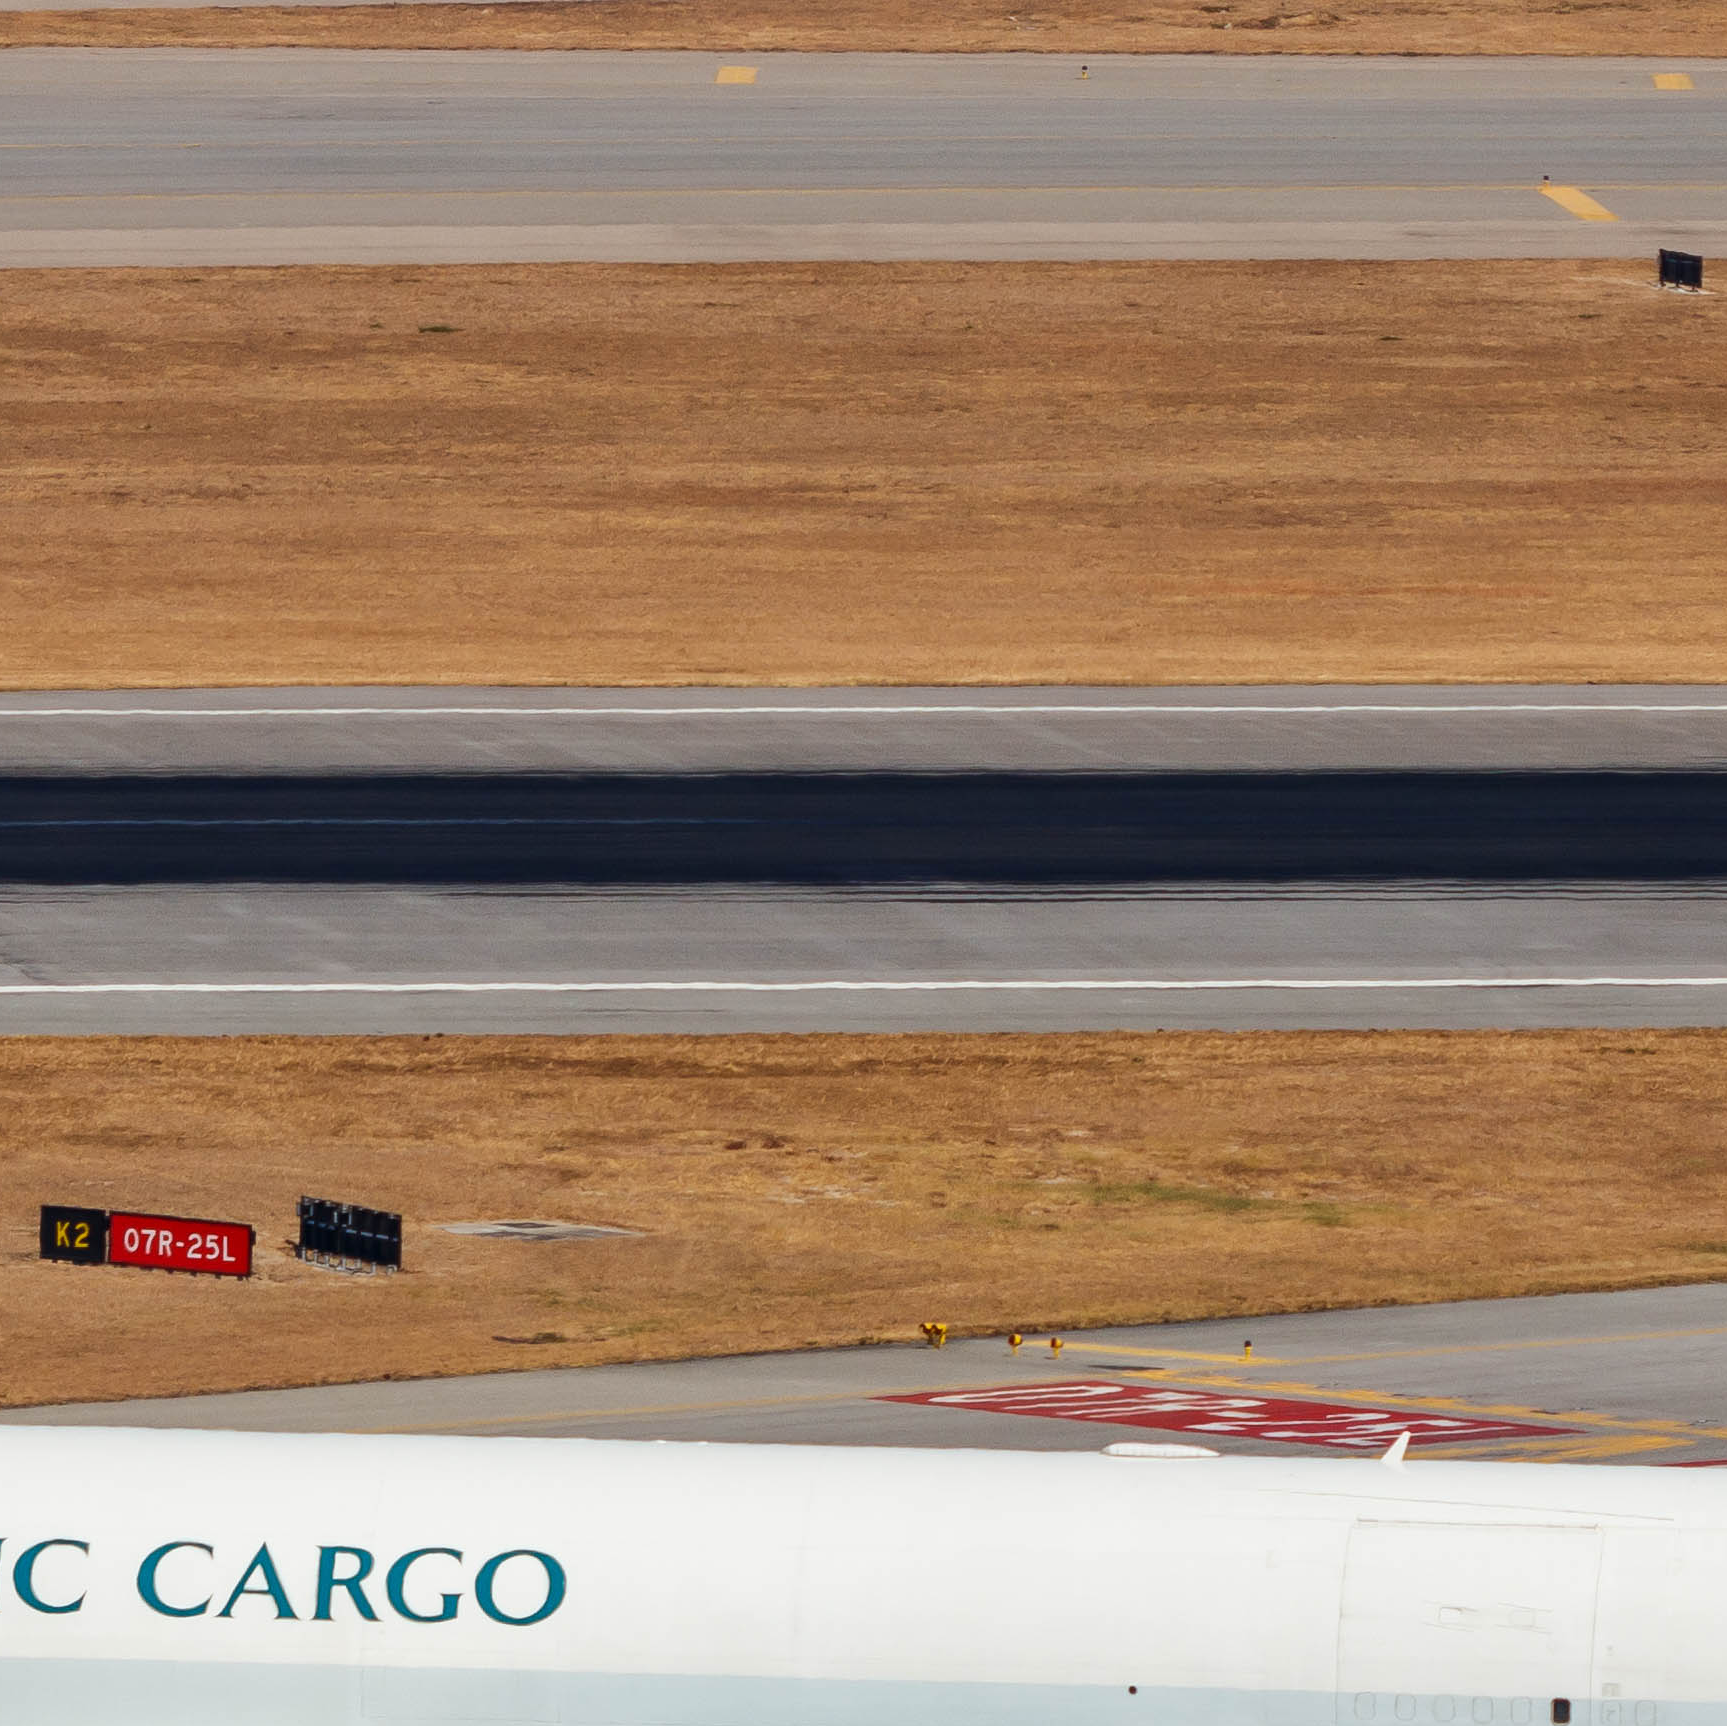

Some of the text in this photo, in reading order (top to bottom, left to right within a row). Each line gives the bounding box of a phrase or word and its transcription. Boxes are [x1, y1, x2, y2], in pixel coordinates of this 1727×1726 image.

[56, 1220, 90, 1248] K2
[123, 1227, 237, 1262] 07R-25L
[136, 1540, 568, 1627] CARGO
